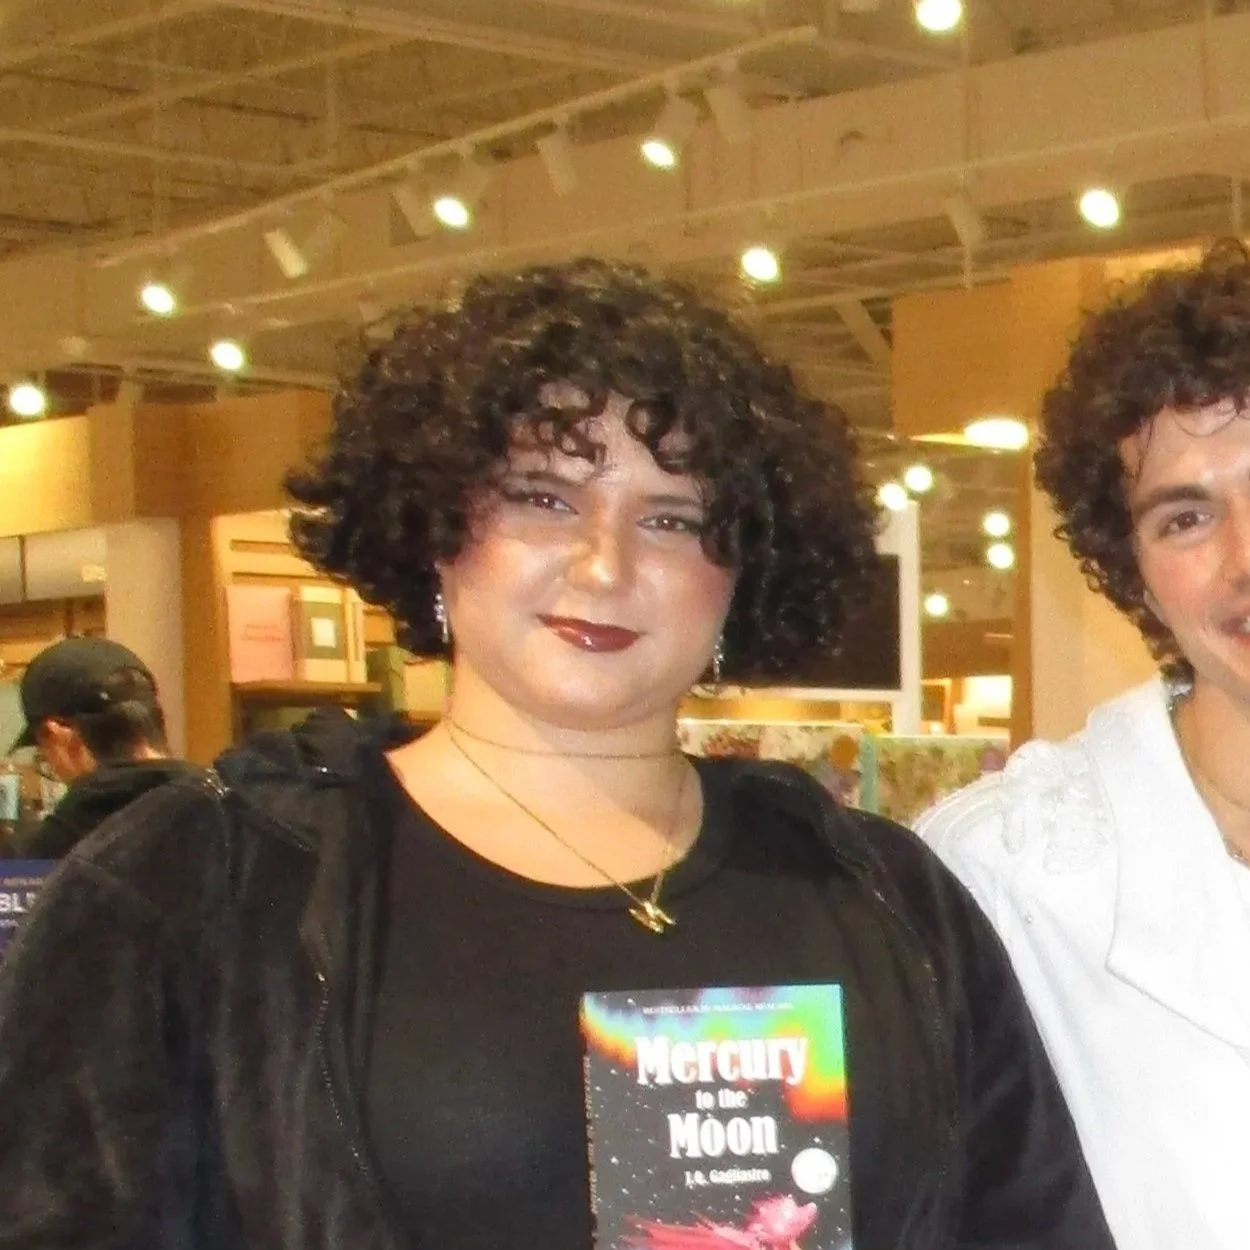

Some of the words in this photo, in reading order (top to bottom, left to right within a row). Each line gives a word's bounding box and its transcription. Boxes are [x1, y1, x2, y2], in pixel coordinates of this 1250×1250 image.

[634, 1034, 808, 1086] Mercury
[695, 1089, 715, 1110] to
[718, 1088, 748, 1109] the
[667, 1112, 780, 1159] Moon
